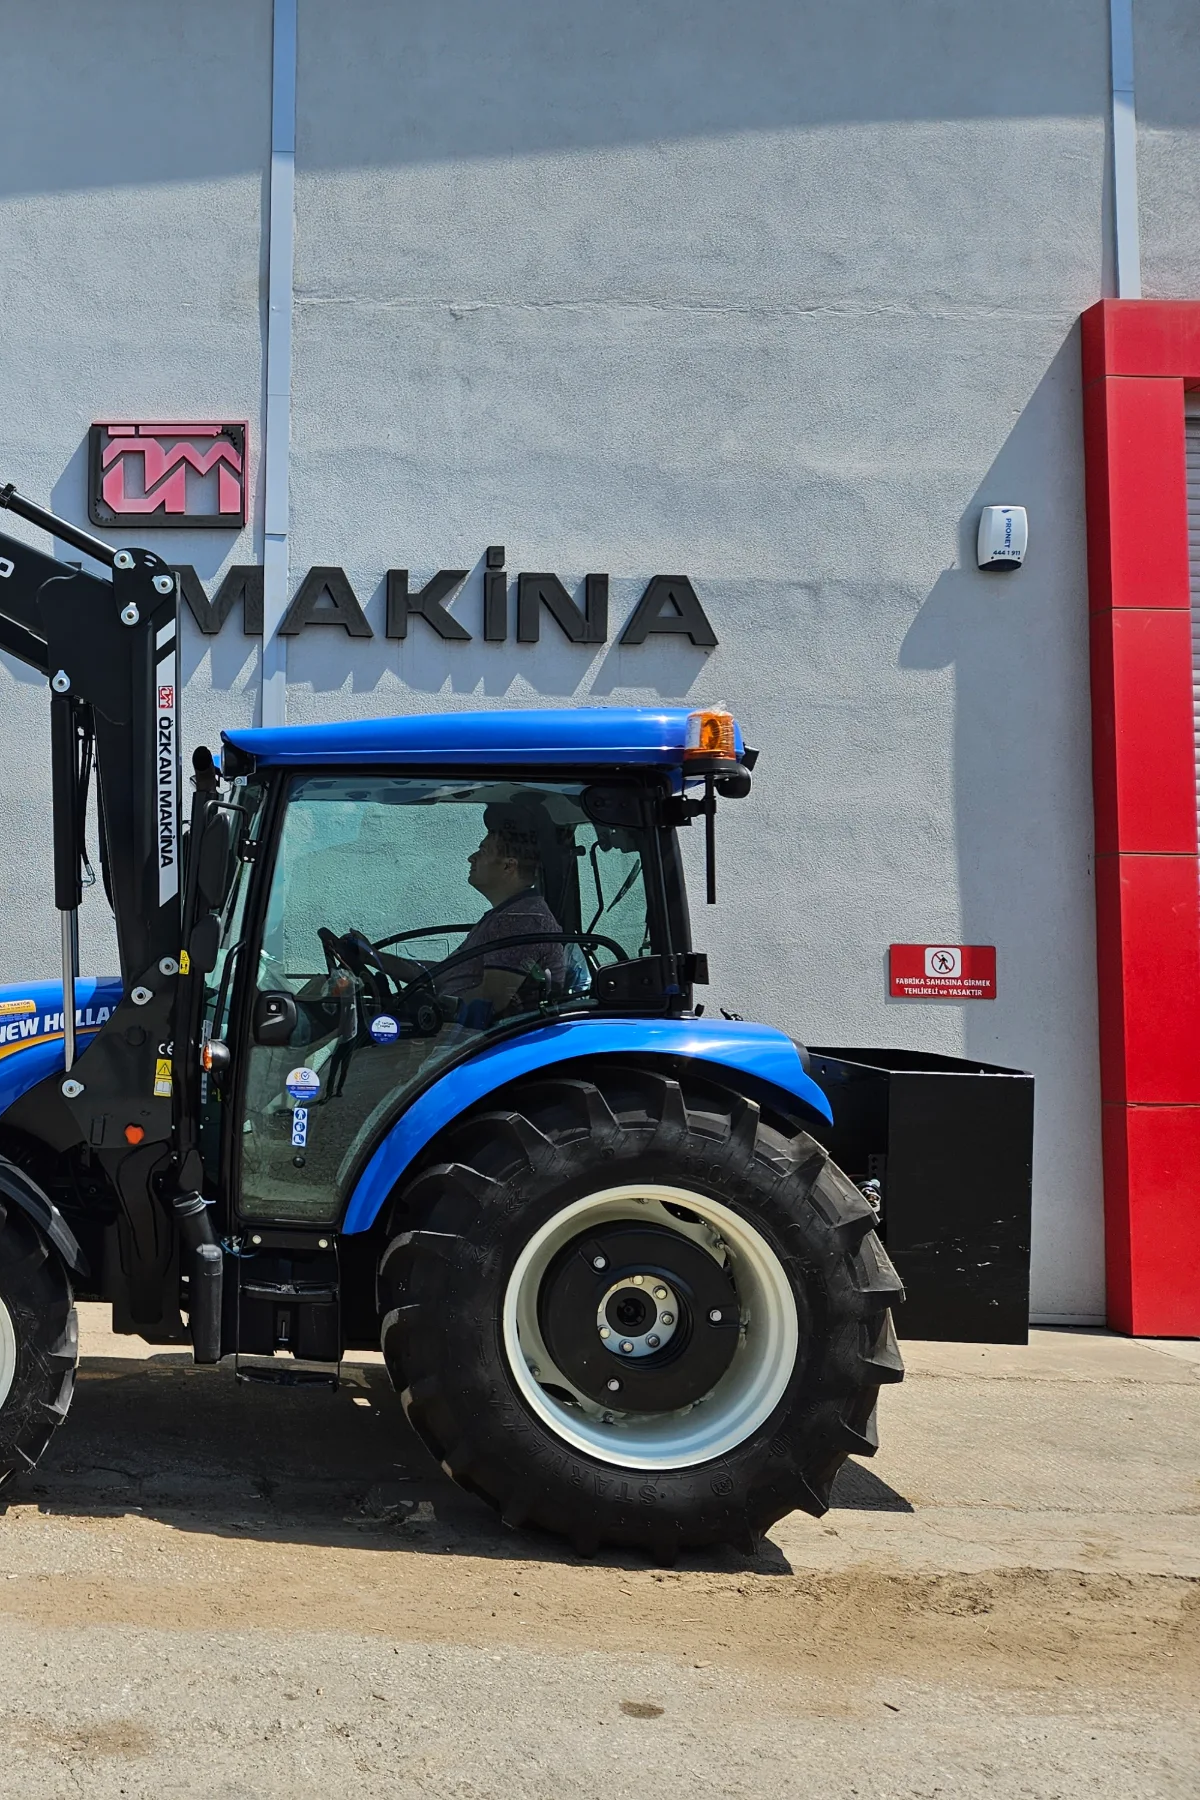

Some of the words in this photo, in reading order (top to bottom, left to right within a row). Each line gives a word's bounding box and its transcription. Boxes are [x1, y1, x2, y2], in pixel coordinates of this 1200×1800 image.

[1004, 518, 1012, 548] PRONET
[158, 716, 174, 785] ÖZKAN
[159, 790, 176, 868] MAKİNA
[896, 976, 925, 985] FABRİKA
[926, 977, 962, 986] SAHASINA
[963, 978, 991, 987] GİRMEK
[904, 986, 938, 995] TEHLİKELİ
[949, 988, 983, 996] YASAKTIR
[44, 1006, 117, 1033] HLLA
